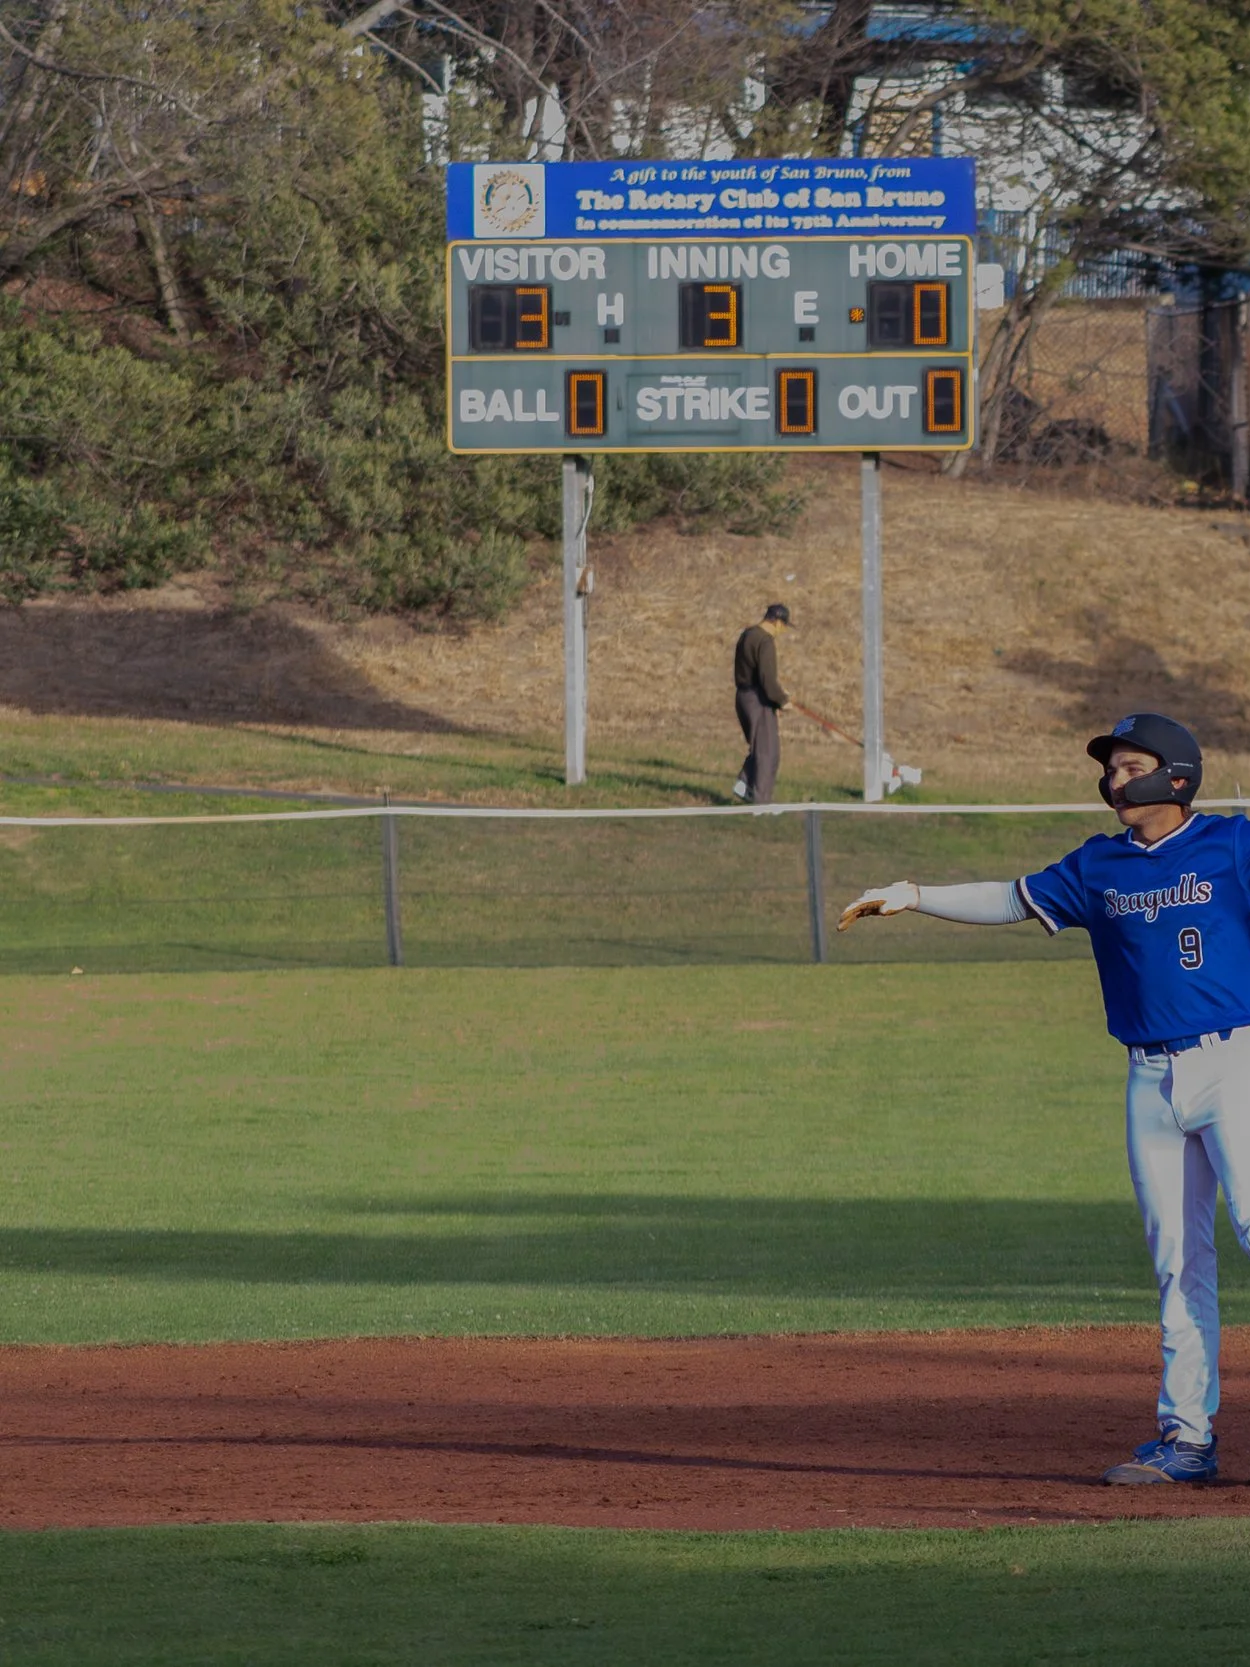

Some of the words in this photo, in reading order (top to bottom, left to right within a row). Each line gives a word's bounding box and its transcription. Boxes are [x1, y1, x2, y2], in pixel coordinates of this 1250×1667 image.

[609, 168, 625, 182] A
[627, 167, 657, 185] gift
[661, 168, 678, 181] to
[681, 167, 707, 181] the
[711, 166, 757, 184] youth
[760, 166, 780, 183] of
[780, 166, 810, 180] San
[814, 166, 868, 181] Bruno,
[868, 165, 911, 182] from
[576, 189, 624, 211] The
[628, 189, 716, 213] Rotary
[719, 188, 780, 209] Club
[783, 188, 811, 209] of
[814, 187, 861, 208] San
[866, 186, 946, 207] Bruno
[598, 215, 741, 230] commemoration
[743, 215, 763, 229] of
[791, 215, 833, 229] 75th
[836, 214, 946, 229] Anniversary
[458, 247, 606, 280] VISITOR
[648, 244, 790, 279] INNING
[850, 243, 962, 277] HOME
[516, 287, 548, 348] 3
[597, 292, 624, 326] H
[704, 285, 737, 347] 3
[794, 291, 819, 324] E
[913, 283, 947, 345] 0
[459, 389, 560, 422] BALL
[570, 373, 603, 434] 0
[636, 386, 771, 421] STRIKE
[780, 371, 814, 433] 0
[838, 385, 918, 420] OUT
[927, 370, 961, 432] 0
[1104, 872, 1212, 922] Seagulls
[1178, 927, 1203, 970] 9
